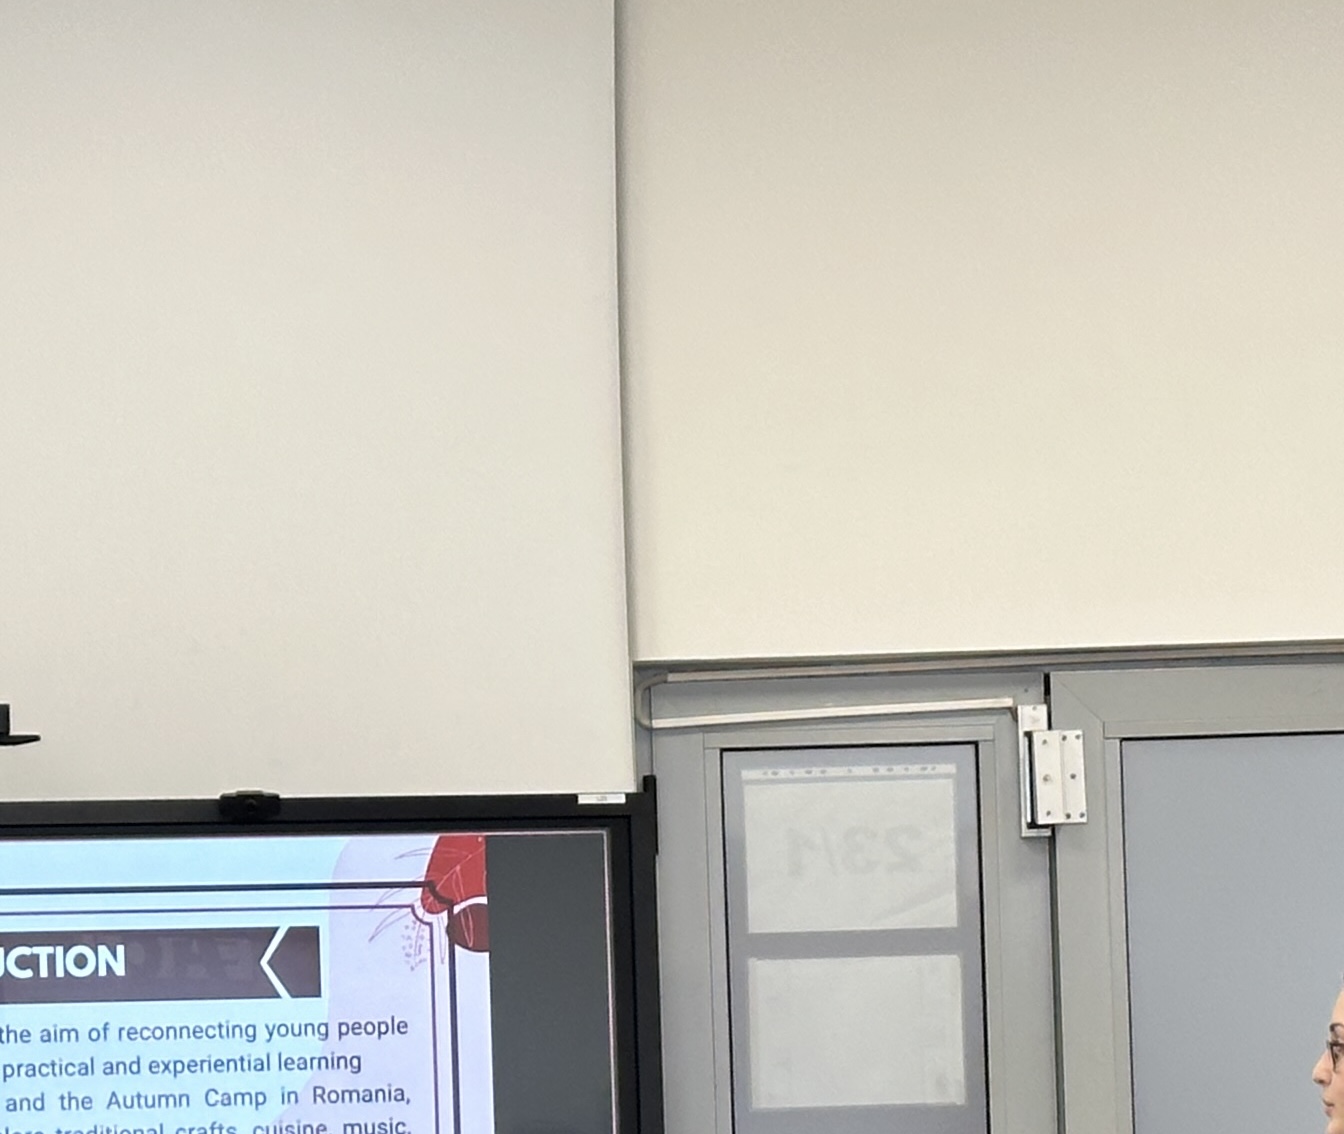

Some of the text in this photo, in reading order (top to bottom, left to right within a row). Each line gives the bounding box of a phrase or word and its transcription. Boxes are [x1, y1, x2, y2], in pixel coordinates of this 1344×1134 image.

[40, 1024, 79, 1043] aim
[88, 1022, 109, 1042] of
[118, 1020, 256, 1043] reconnecting
[265, 1020, 329, 1043] young
[338, 1015, 408, 1041] people
[3, 1056, 94, 1083] practical
[103, 1055, 141, 1075] and
[148, 1052, 270, 1079] experiential
[278, 1051, 361, 1074] learning
[6, 1092, 45, 1112] and
[59, 1091, 92, 1111] the
[107, 1091, 190, 1109] Autumn
[205, 1088, 267, 1111] Camp
[281, 1087, 299, 1105] in
[313, 1084, 410, 1105] Romania,
